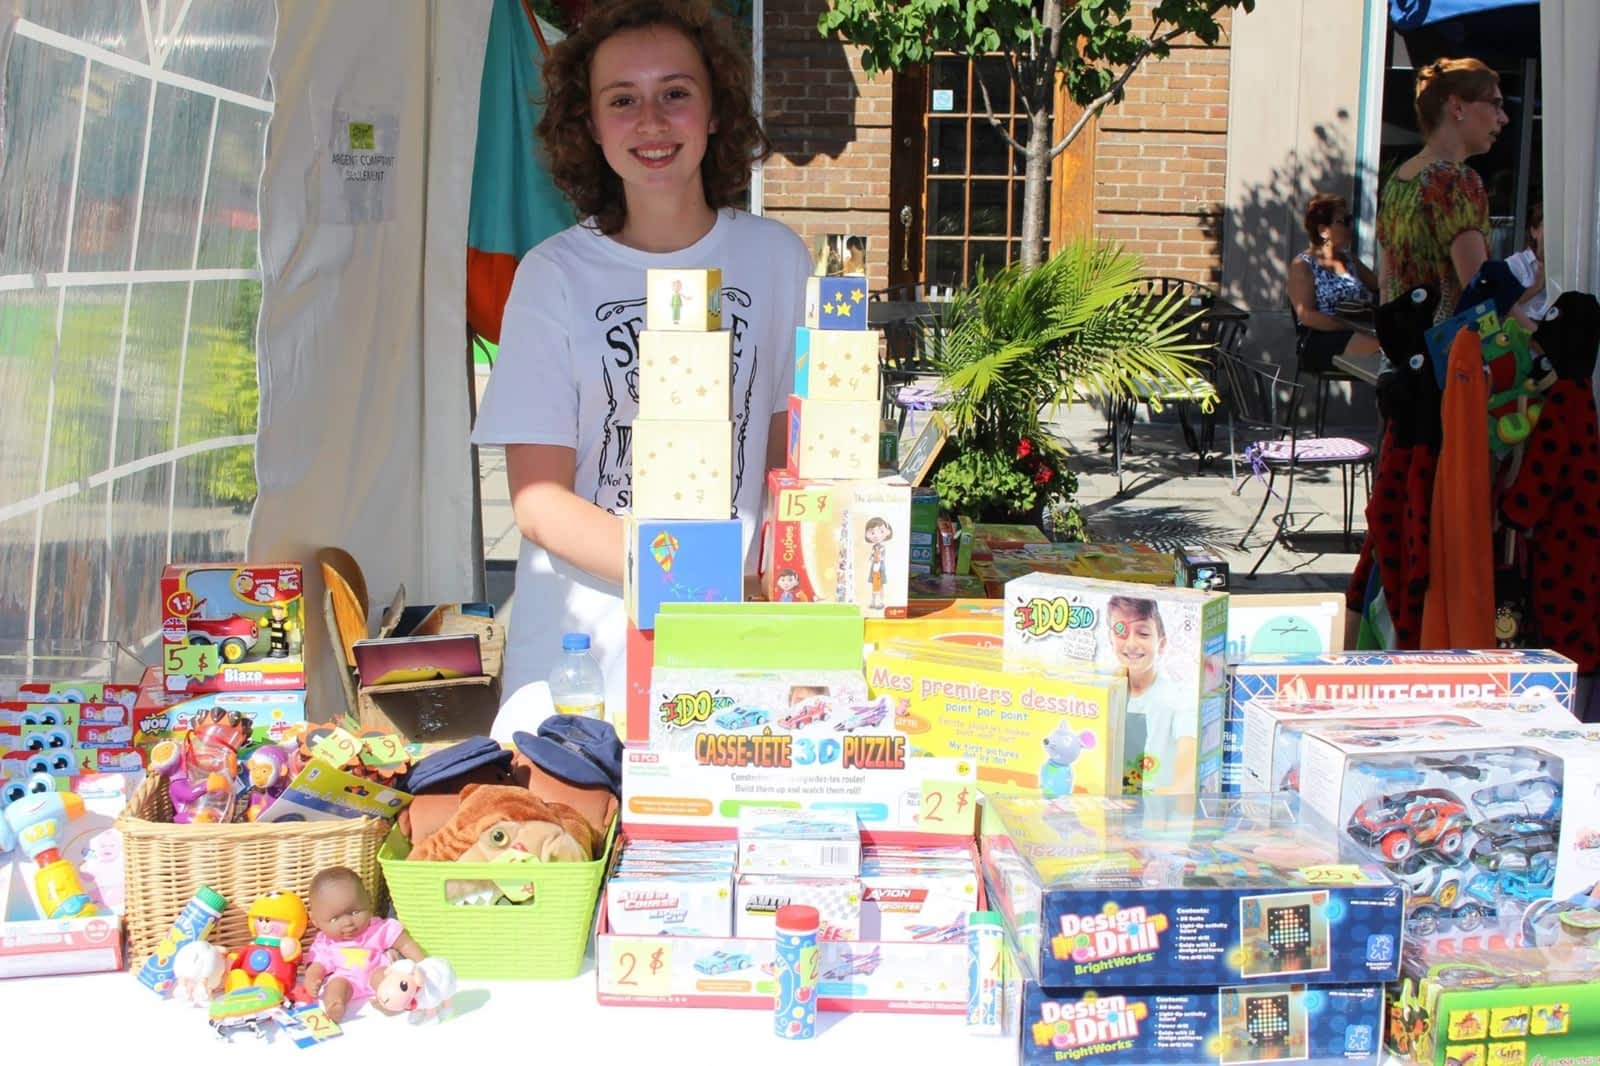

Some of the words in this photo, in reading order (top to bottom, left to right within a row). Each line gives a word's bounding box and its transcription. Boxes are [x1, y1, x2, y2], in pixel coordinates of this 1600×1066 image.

[849, 377, 860, 392] 4
[671, 391, 682, 405] 6
[786, 493, 808, 517] 15
[817, 494, 829, 513] $
[167, 646, 189, 671] 5
[198, 653, 209, 672] $
[224, 667, 263, 683] Blaze
[872, 667, 913, 690] Mes
[921, 678, 1012, 706] premiers
[1021, 687, 1099, 717] dessins
[945, 703, 972, 714] point
[1000, 711, 1029, 721] point
[139, 719, 169, 731] WOW
[694, 726, 793, 768] CASSE-TÊTE
[794, 737, 841, 766] 3D
[842, 735, 906, 769] PUZZLE
[924, 791, 944, 822] 2
[957, 786, 970, 815] $
[871, 888, 912, 900] AVION
[1060, 905, 1148, 938] Design
[1095, 921, 1160, 957] Drill
[617, 952, 638, 986] 2
[649, 947, 665, 976] $
[1074, 952, 1155, 976] BrightWorks
[1041, 995, 1126, 1025] Design
[307, 1014, 329, 1033] 2
[1075, 1009, 1140, 1044] Drill
[1055, 1039, 1134, 1062] BrightWorks
